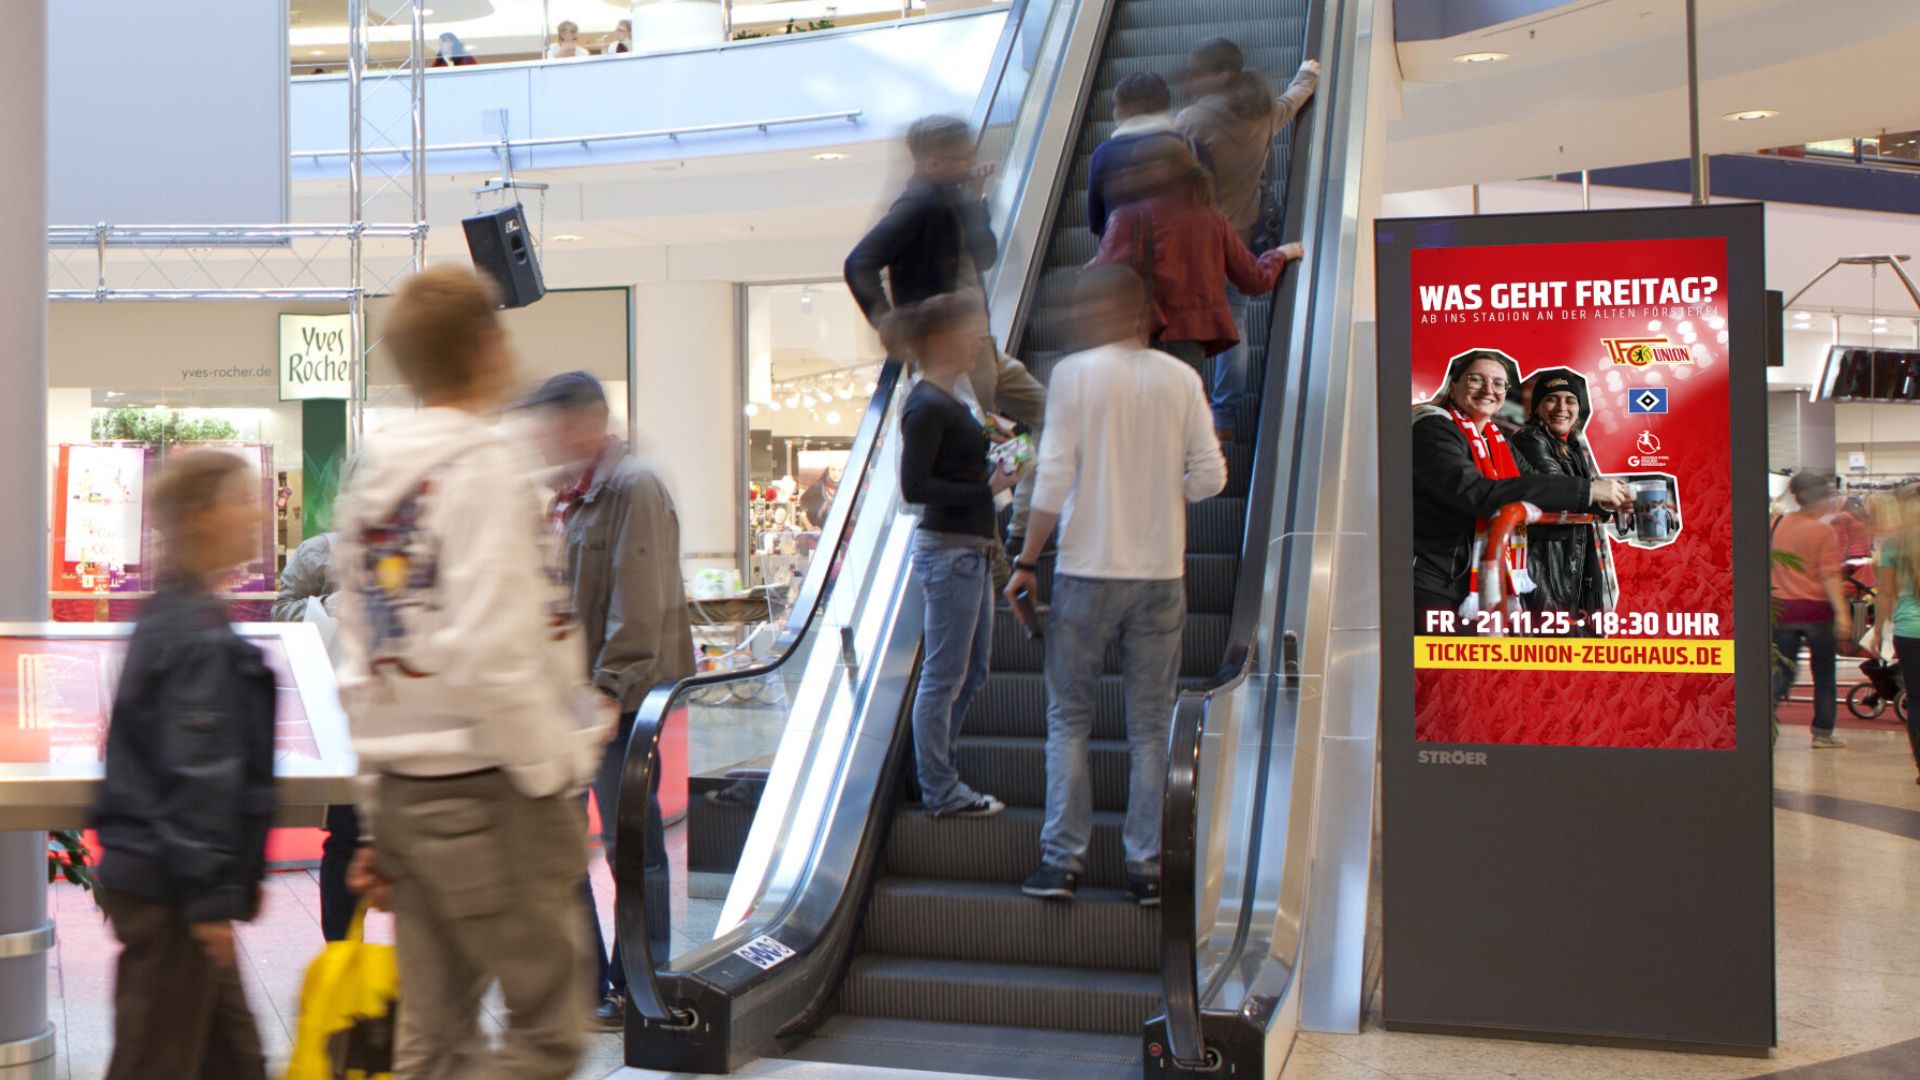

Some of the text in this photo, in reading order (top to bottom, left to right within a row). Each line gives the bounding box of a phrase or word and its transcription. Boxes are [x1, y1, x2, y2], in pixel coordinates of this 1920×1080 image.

[1419, 276, 1718, 311] WAS GEHT FREITAG?
[1421, 305, 1718, 324] AB INS STADION AN DER ALTEN FÖRSTEREI
[302, 327, 344, 356] Yves
[1652, 347, 1690, 362] UNION
[182, 365, 272, 381] yves-rocher.de
[1426, 610, 1719, 636] FR 21.11.25 18:30 UHR
[1426, 643, 1722, 665] TICKETS.UNION-ZEUGHAUS.DE
